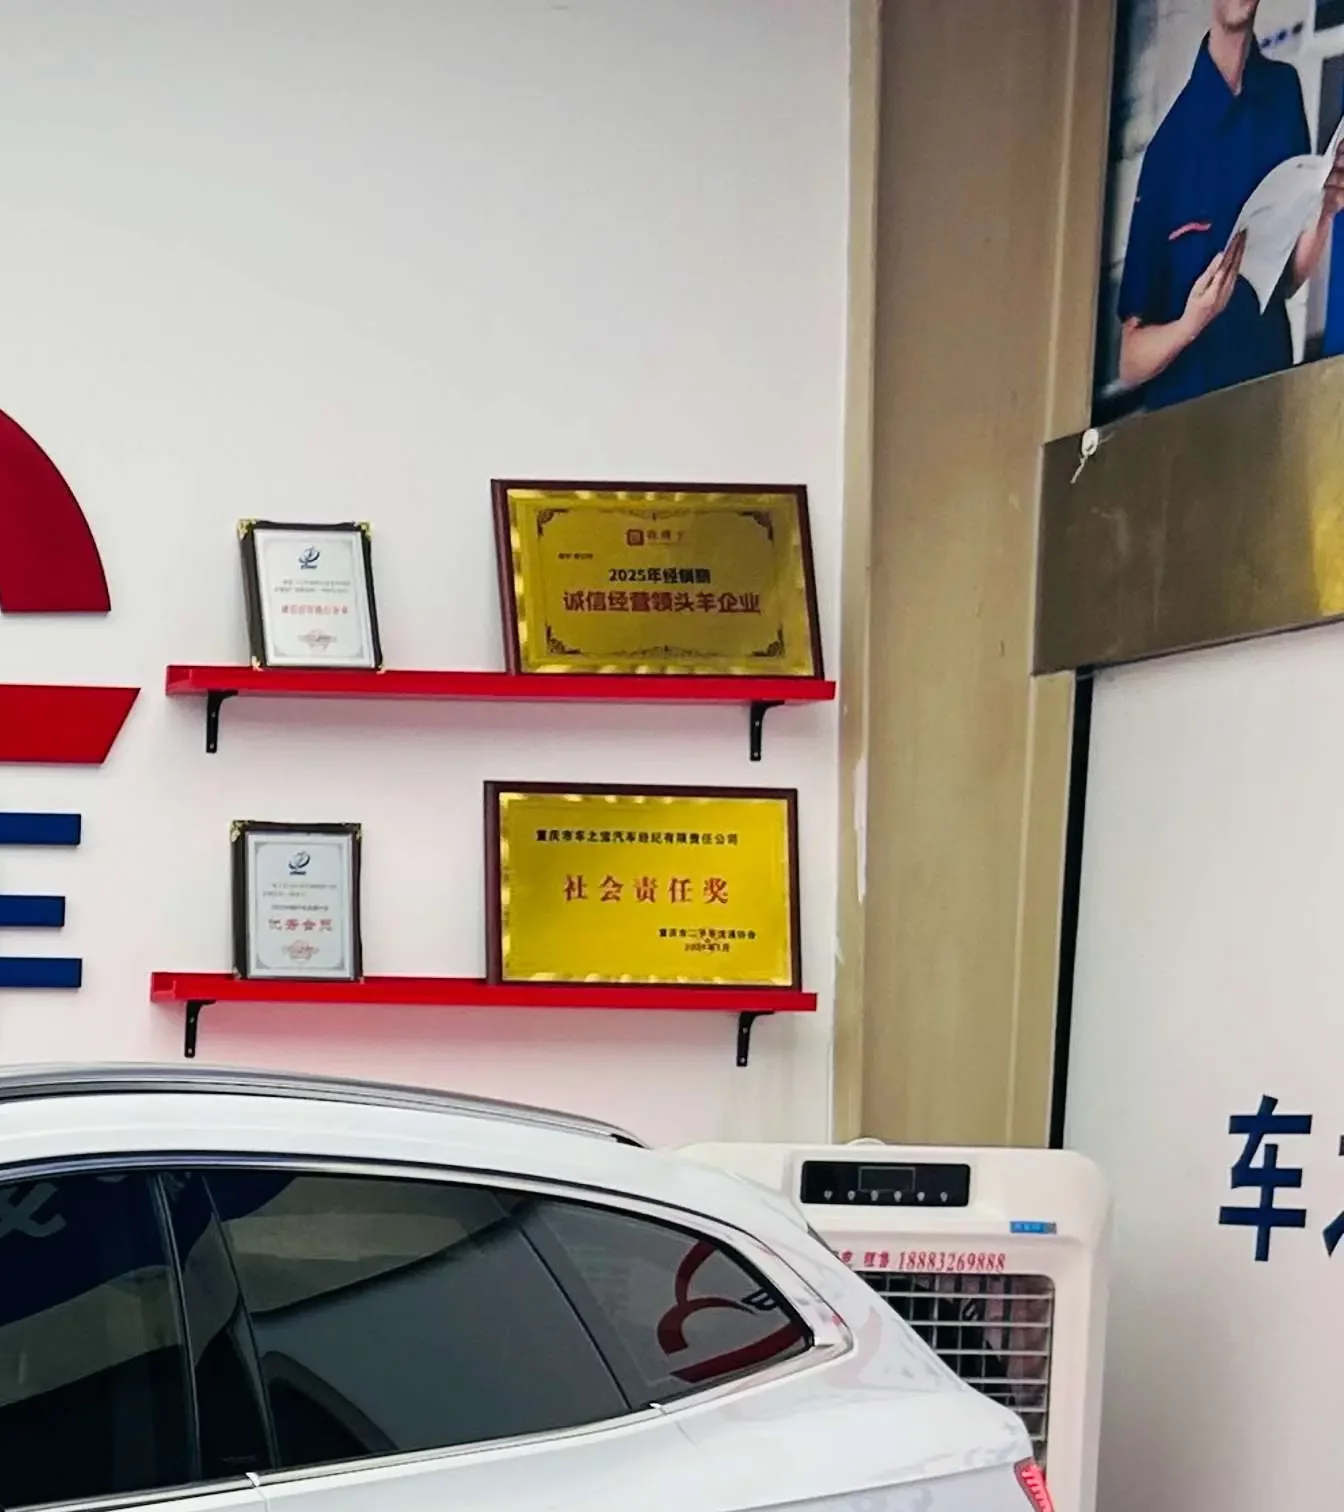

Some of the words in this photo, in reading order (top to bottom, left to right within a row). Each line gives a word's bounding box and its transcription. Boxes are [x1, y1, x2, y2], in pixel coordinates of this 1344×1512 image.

[563, 590, 762, 615] 诚信经营领头羊企业
[563, 874, 730, 905] 社会责任奖
[898, 1252, 1007, 1273] 18883269888
